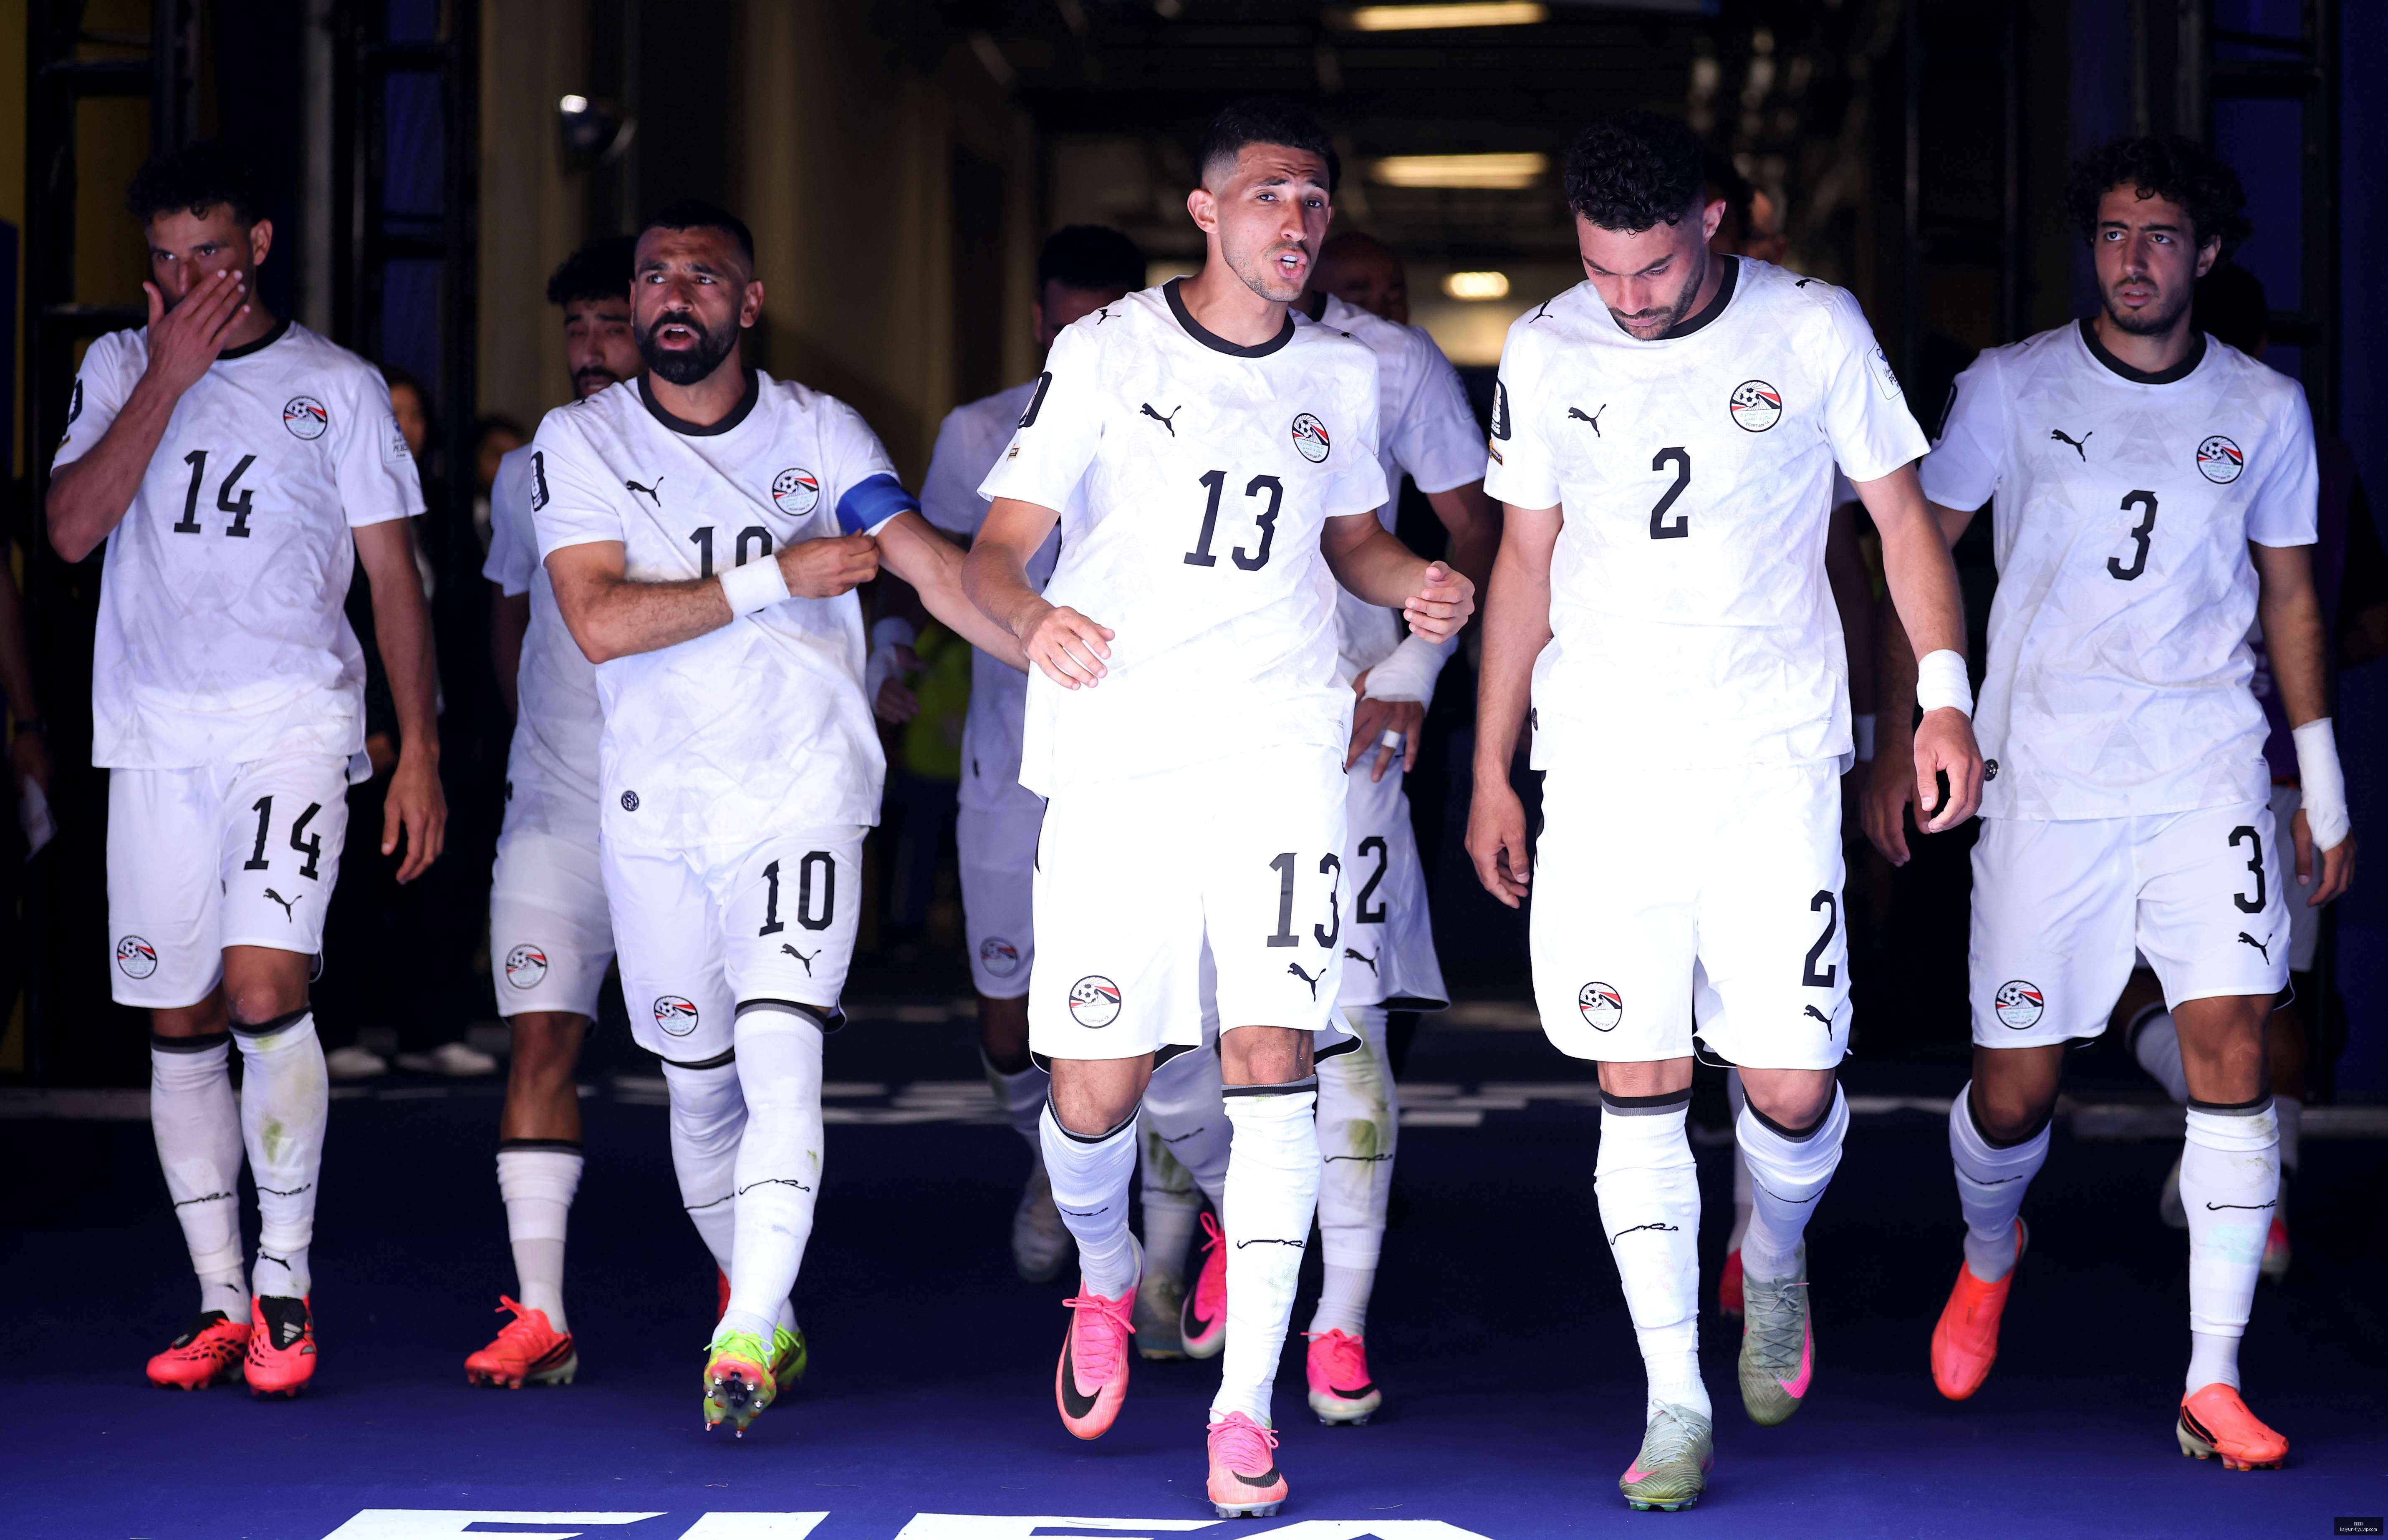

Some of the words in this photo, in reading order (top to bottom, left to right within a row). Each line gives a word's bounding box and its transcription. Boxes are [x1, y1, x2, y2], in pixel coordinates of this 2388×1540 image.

[174, 451, 256, 537] 14
[1184, 470, 1283, 571] 13
[1650, 447, 1690, 539] 2
[2108, 490, 2158, 580] 3
[244, 796, 321, 881] 14
[2229, 826, 2266, 913] 3
[759, 852, 835, 936] 10
[1267, 852, 1340, 949] 13
[1802, 890, 1836, 988] 2
